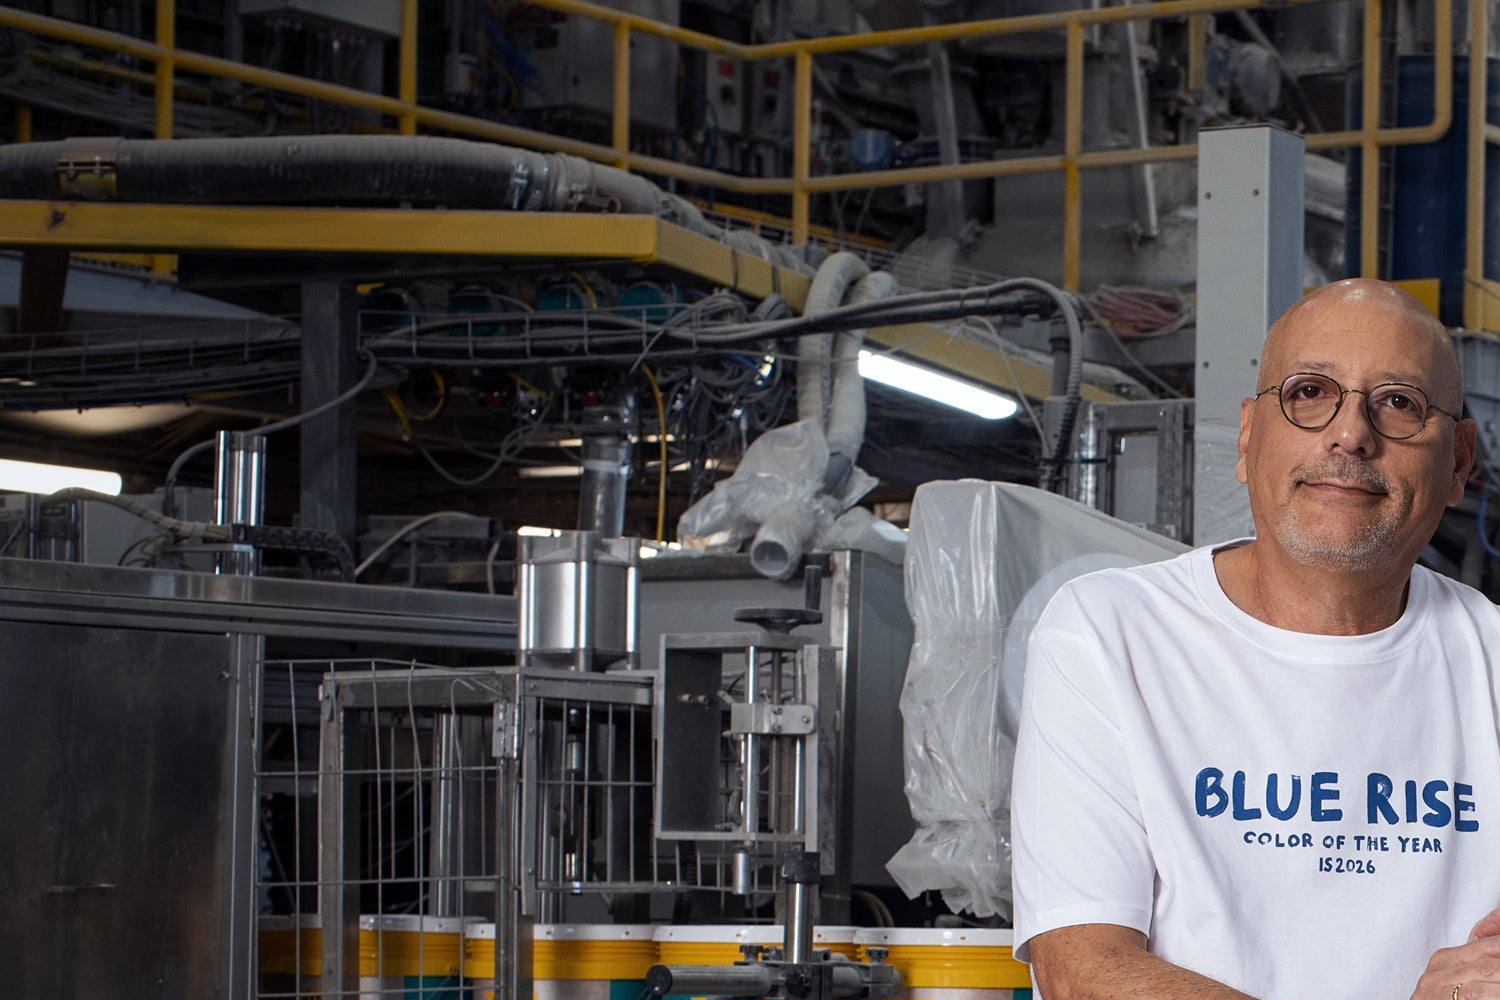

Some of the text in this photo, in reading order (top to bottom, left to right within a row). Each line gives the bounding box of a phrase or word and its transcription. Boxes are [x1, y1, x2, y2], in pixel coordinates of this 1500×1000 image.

[1195, 767, 1480, 833] BLUE RISE
[1243, 831, 1443, 853] COLOR OF THE YEAR
